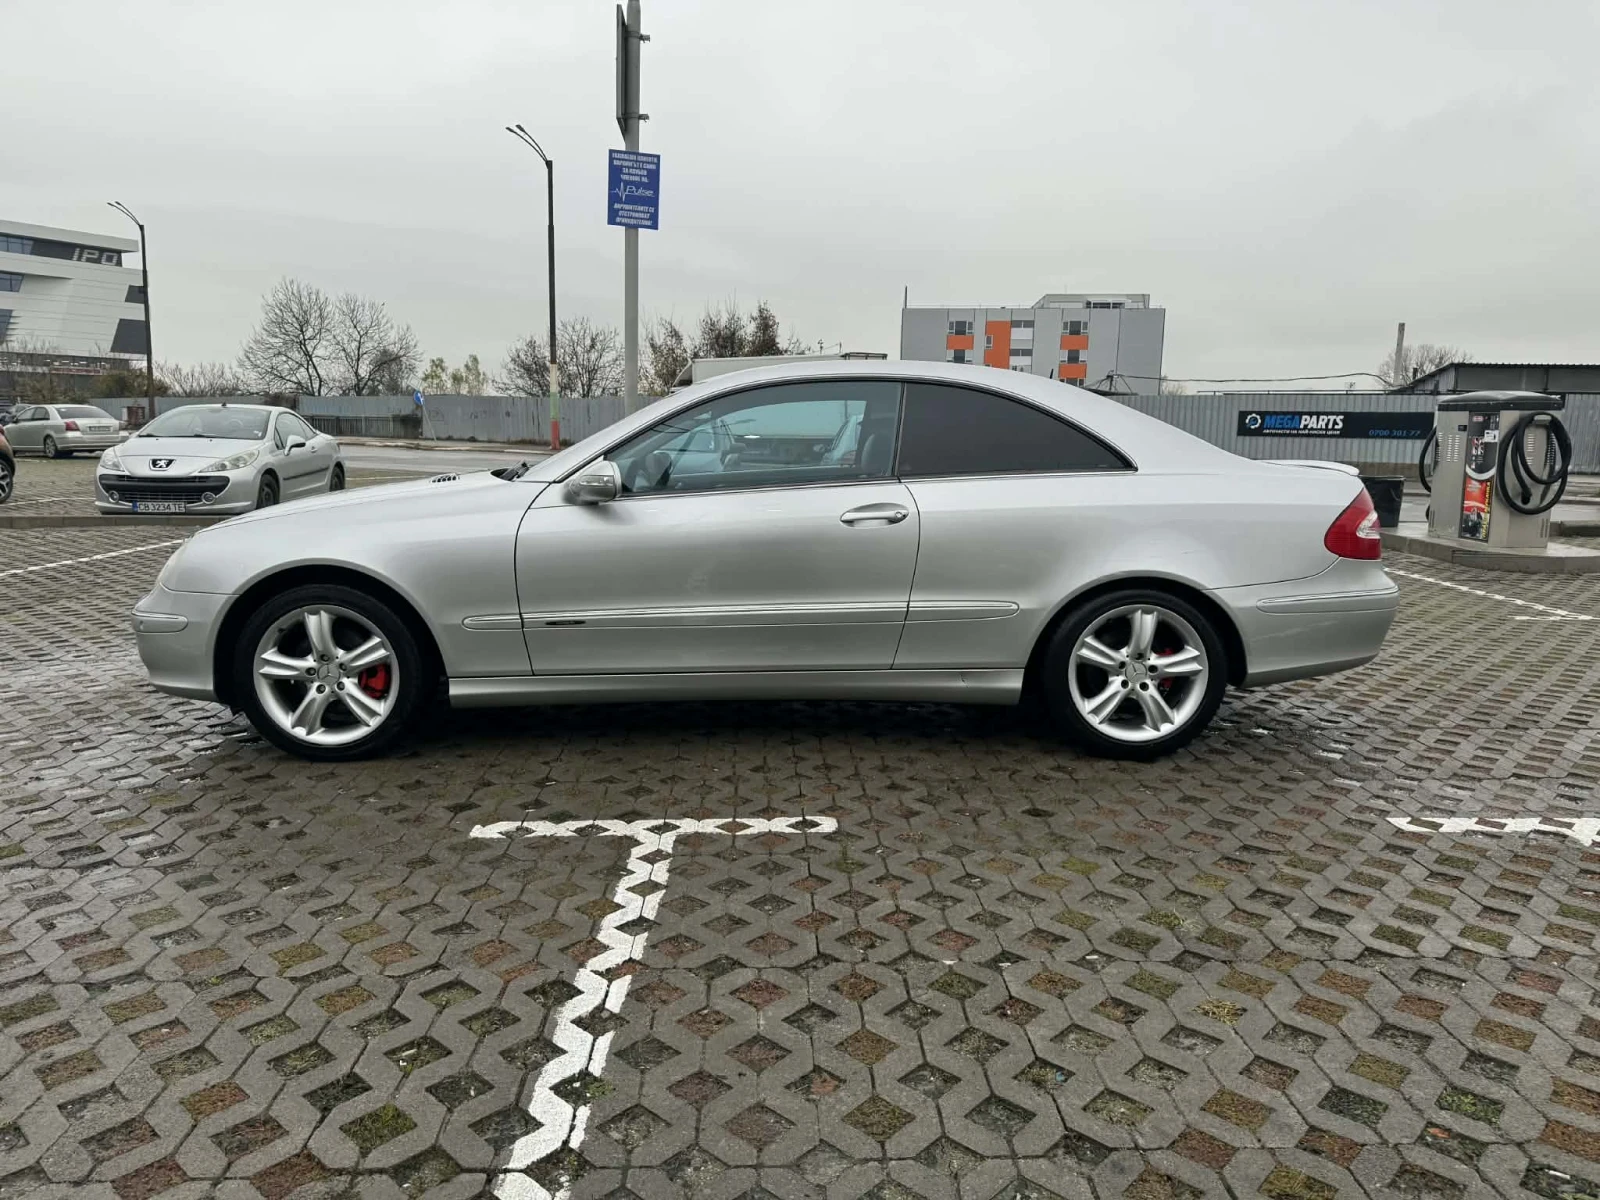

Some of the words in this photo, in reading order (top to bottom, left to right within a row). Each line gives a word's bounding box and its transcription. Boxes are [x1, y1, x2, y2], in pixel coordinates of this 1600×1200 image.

[626, 185, 654, 197] Pulse
[72, 247, 119, 266] IPO
[1263, 414, 1344, 429] MEGAPARTS
[1368, 429, 1390, 437] 0700
[171, 503, 185, 511] TE
